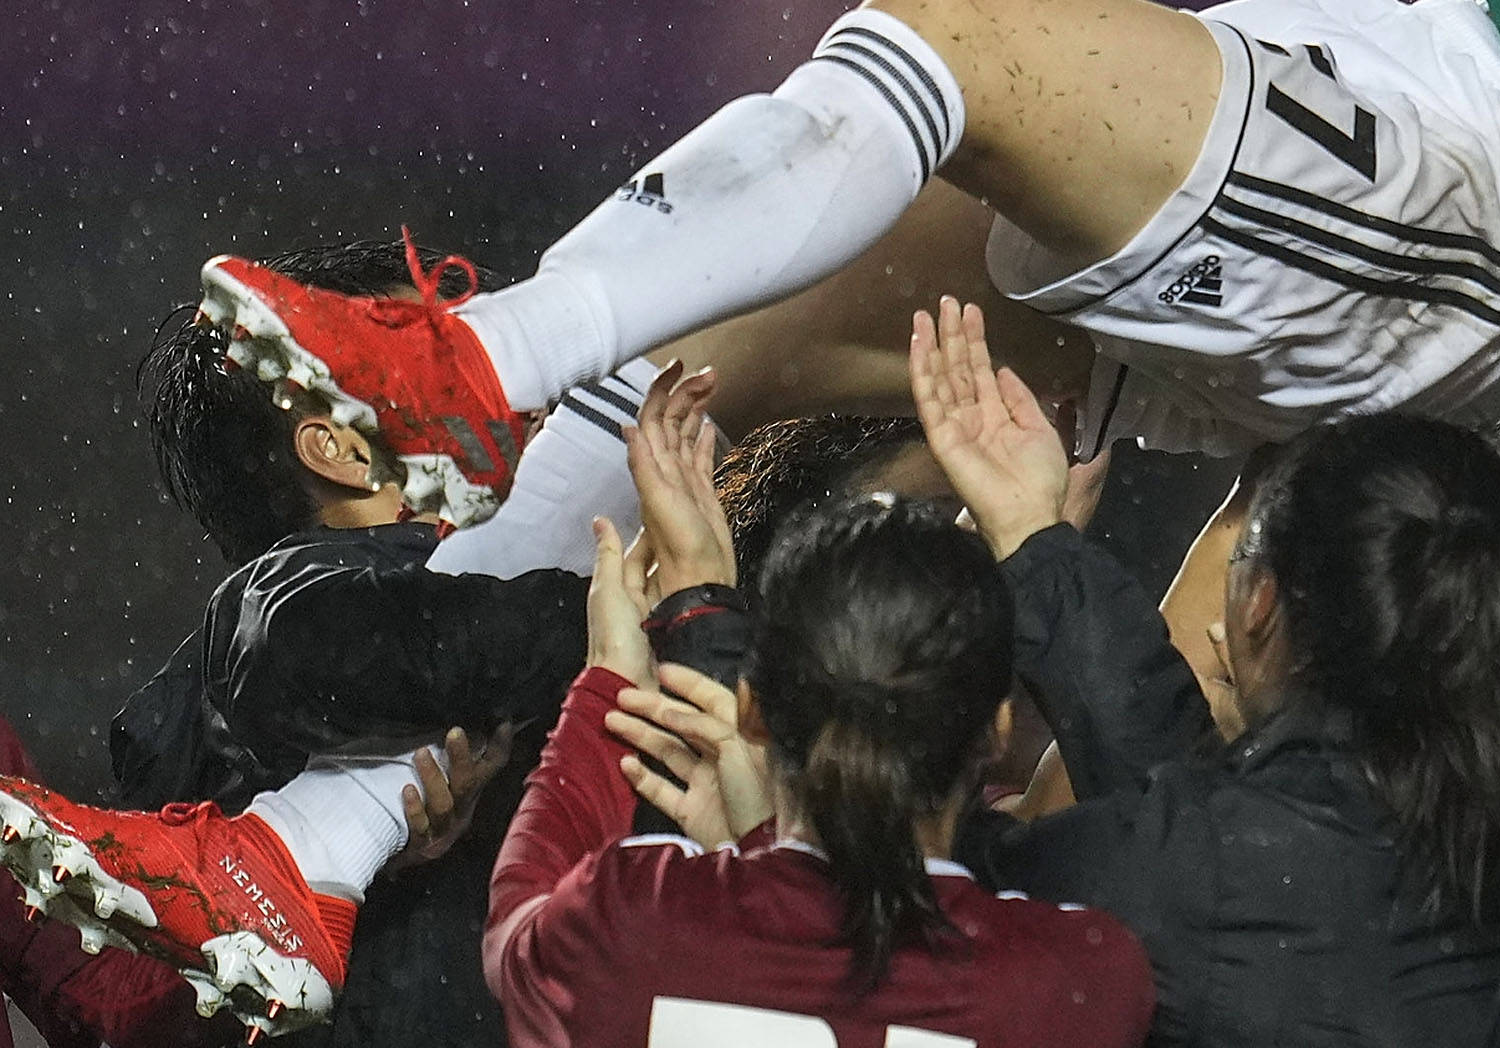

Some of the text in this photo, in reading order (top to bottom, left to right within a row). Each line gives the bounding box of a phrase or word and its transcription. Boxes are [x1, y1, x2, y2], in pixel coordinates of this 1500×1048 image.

[1255, 38, 1377, 185] 7
[1158, 255, 1220, 304] adidas
[218, 855, 304, 952] NEMESIS
